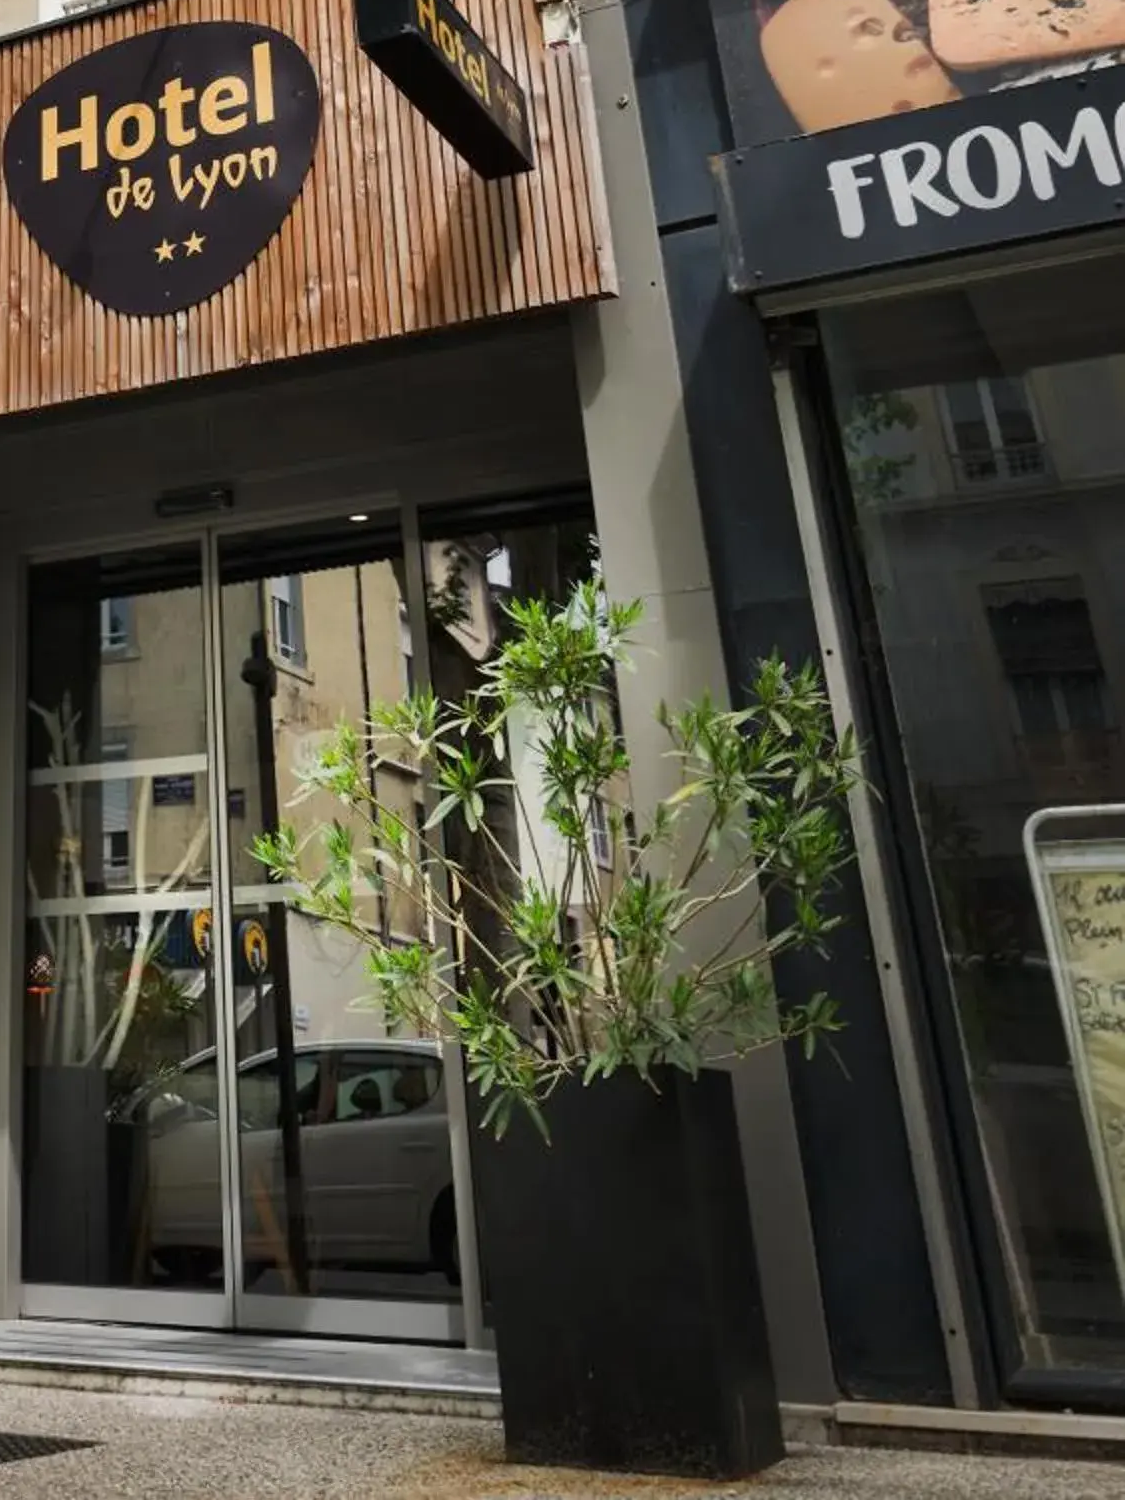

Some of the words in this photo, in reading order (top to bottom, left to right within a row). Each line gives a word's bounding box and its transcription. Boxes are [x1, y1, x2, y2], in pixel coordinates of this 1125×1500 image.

[41, 41, 275, 182] Hotel
[826, 100, 1125, 238] FROM
[106, 167, 155, 218] de
[169, 145, 278, 211] Lyon
